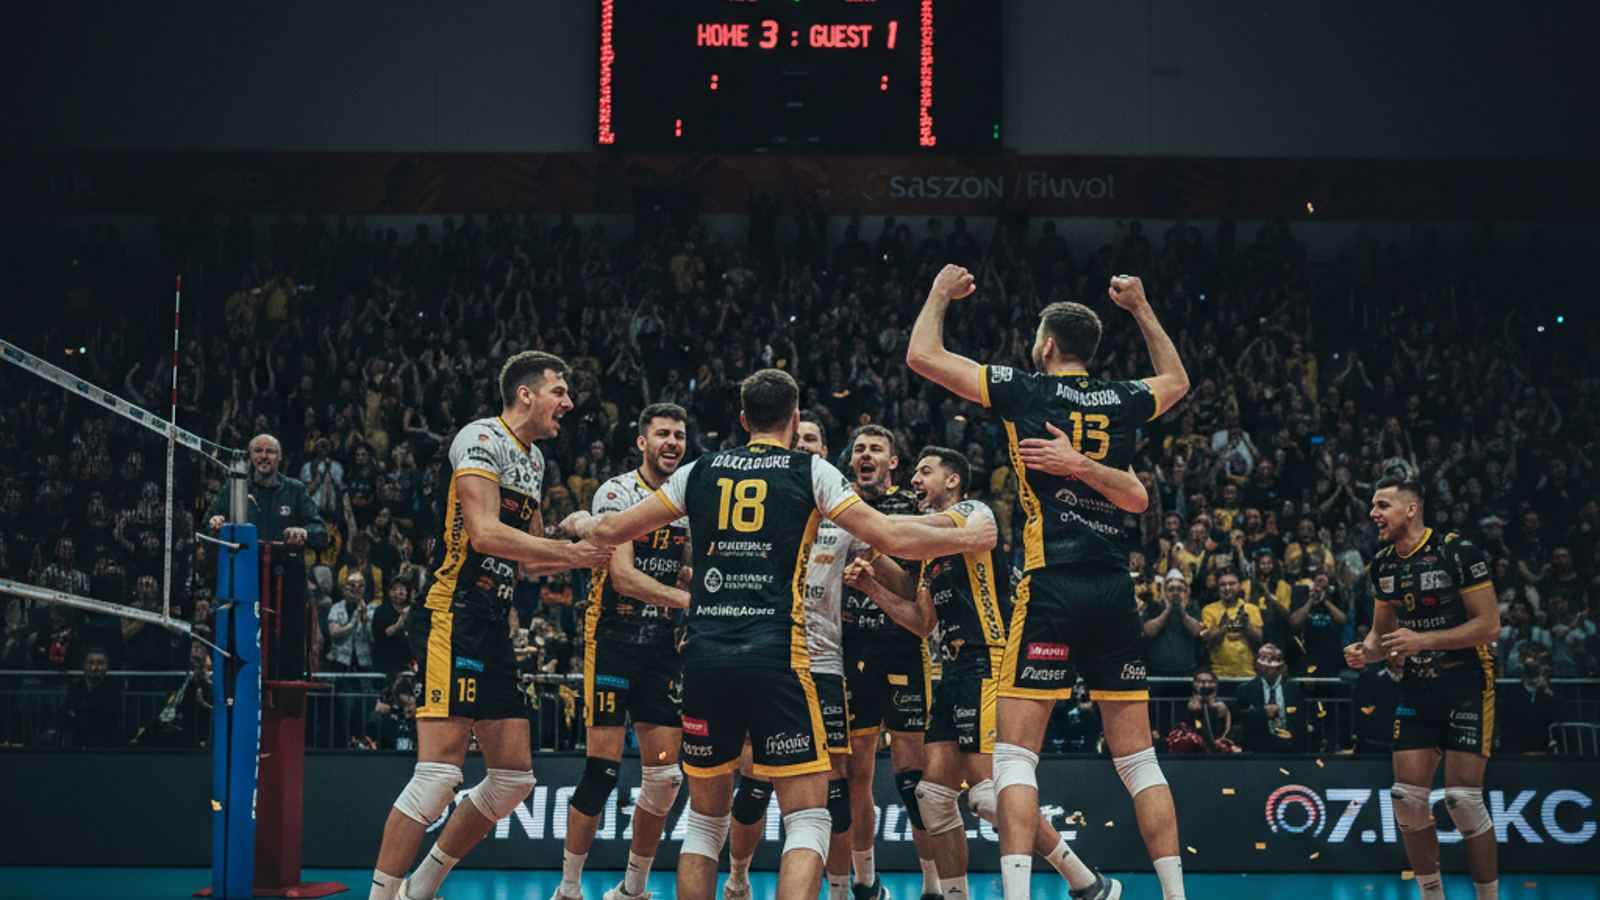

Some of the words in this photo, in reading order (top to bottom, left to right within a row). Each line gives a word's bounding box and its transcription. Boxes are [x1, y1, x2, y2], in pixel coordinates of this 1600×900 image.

[697, 23, 749, 47] HOME
[758, 19, 779, 49] 3
[809, 23, 873, 48] GUEST
[886, 20, 898, 49] 1
[1069, 411, 1110, 460] 13
[717, 477, 768, 533] 18
[457, 677, 476, 702] 18
